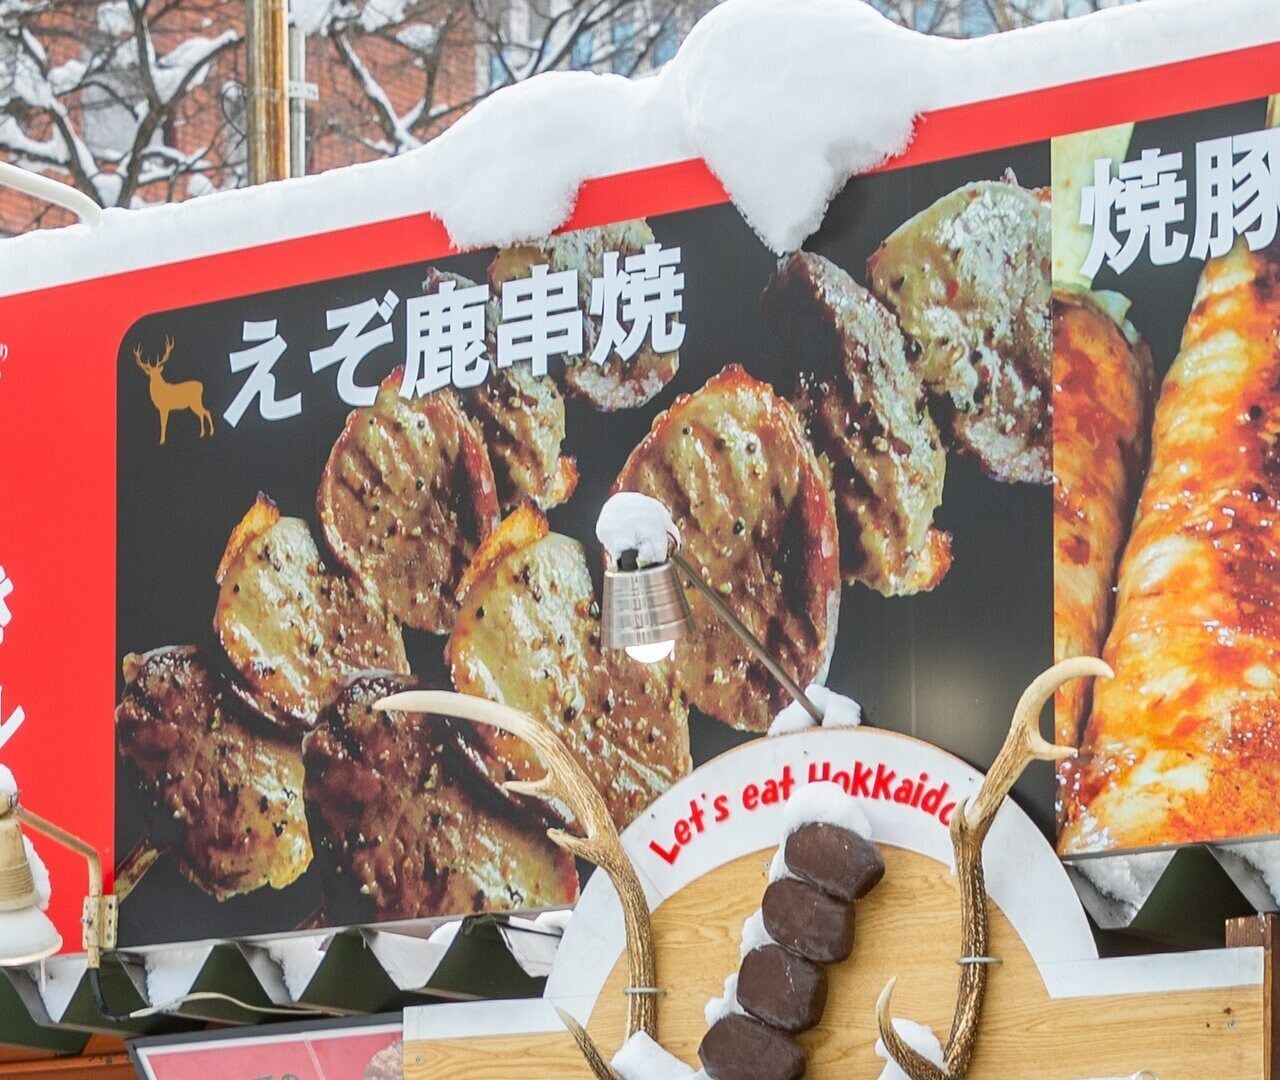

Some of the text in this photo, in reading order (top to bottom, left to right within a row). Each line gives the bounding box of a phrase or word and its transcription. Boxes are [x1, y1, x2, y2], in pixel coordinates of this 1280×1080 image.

[223, 243, 686, 427] えぞ鹿串焼
[649, 792, 731, 866] Let's
[742, 765, 795, 812] eat
